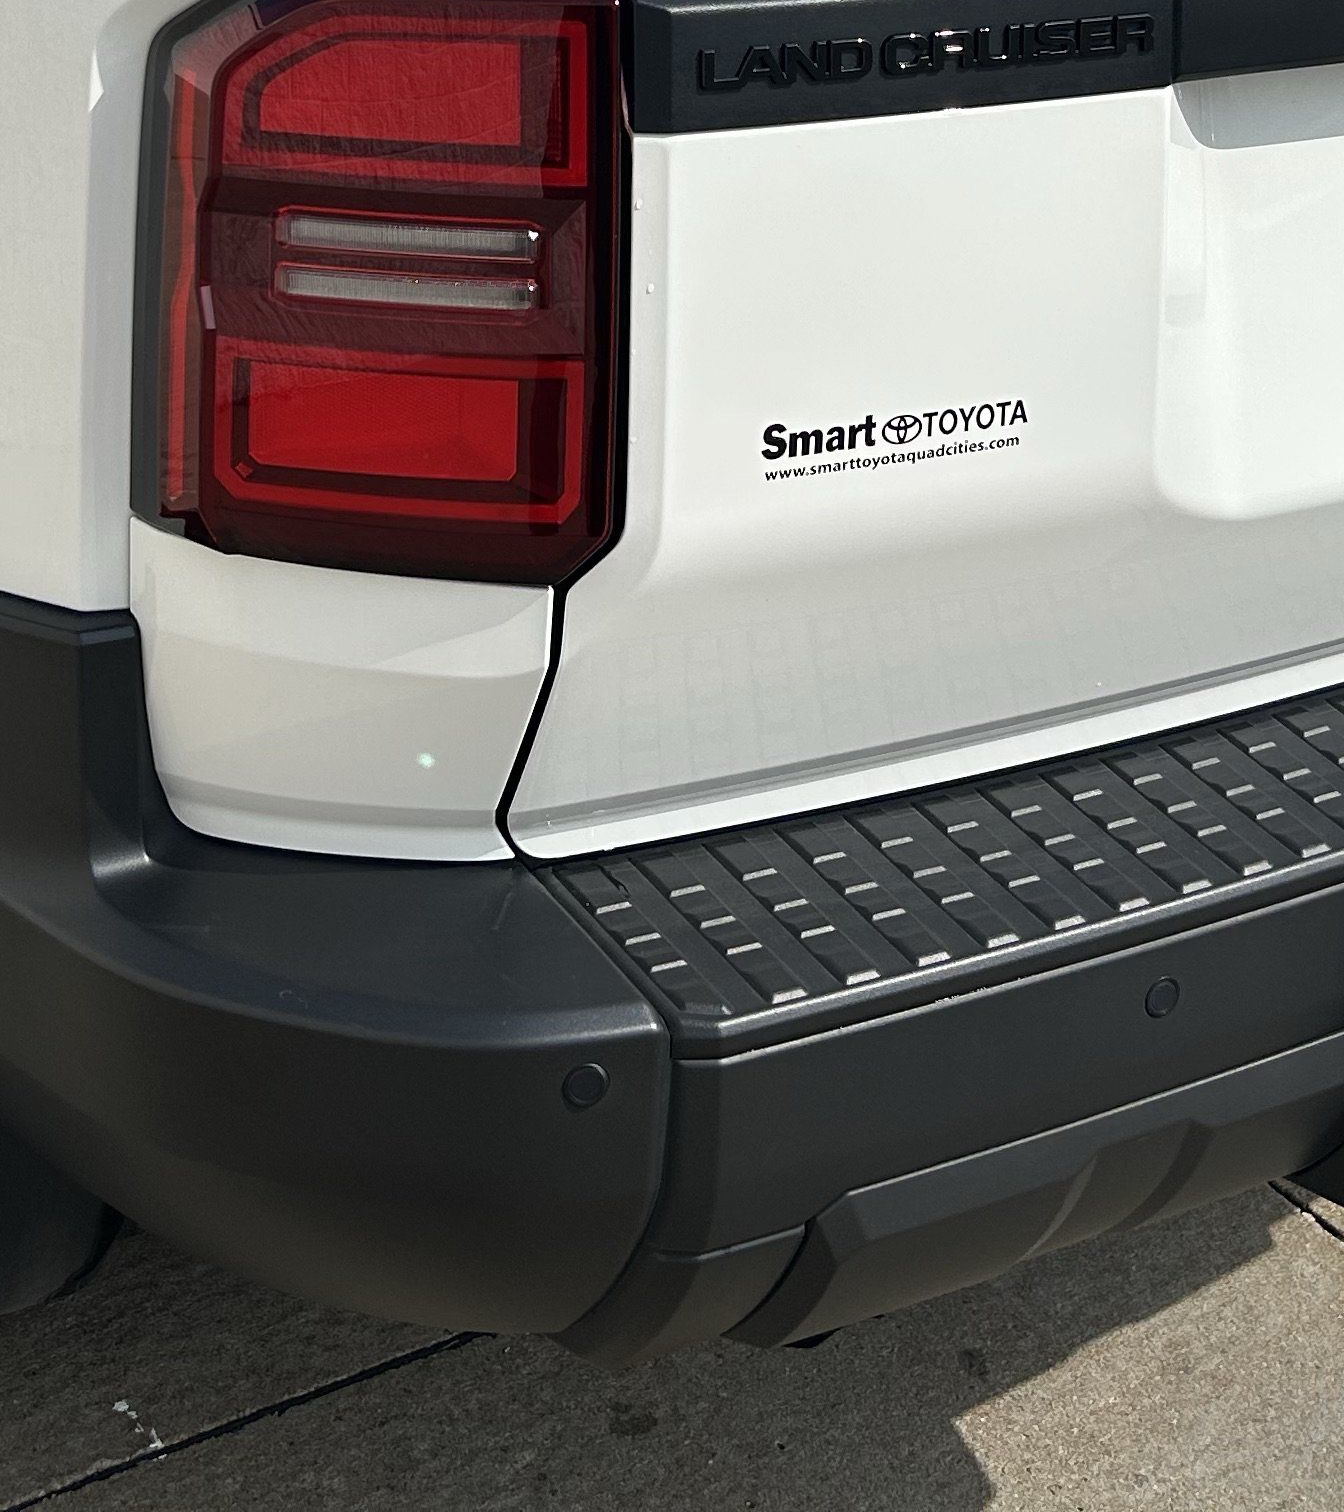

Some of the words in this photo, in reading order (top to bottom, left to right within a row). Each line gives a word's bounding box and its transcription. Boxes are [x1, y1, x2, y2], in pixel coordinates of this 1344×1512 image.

[696, 38, 874, 90] LAND
[880, 12, 1158, 78] CRUISER
[761, 414, 877, 460] Smart
[923, 399, 1028, 437] TOYOTA
[764, 436, 1020, 481] www.smarttoyotaquadcities.com
